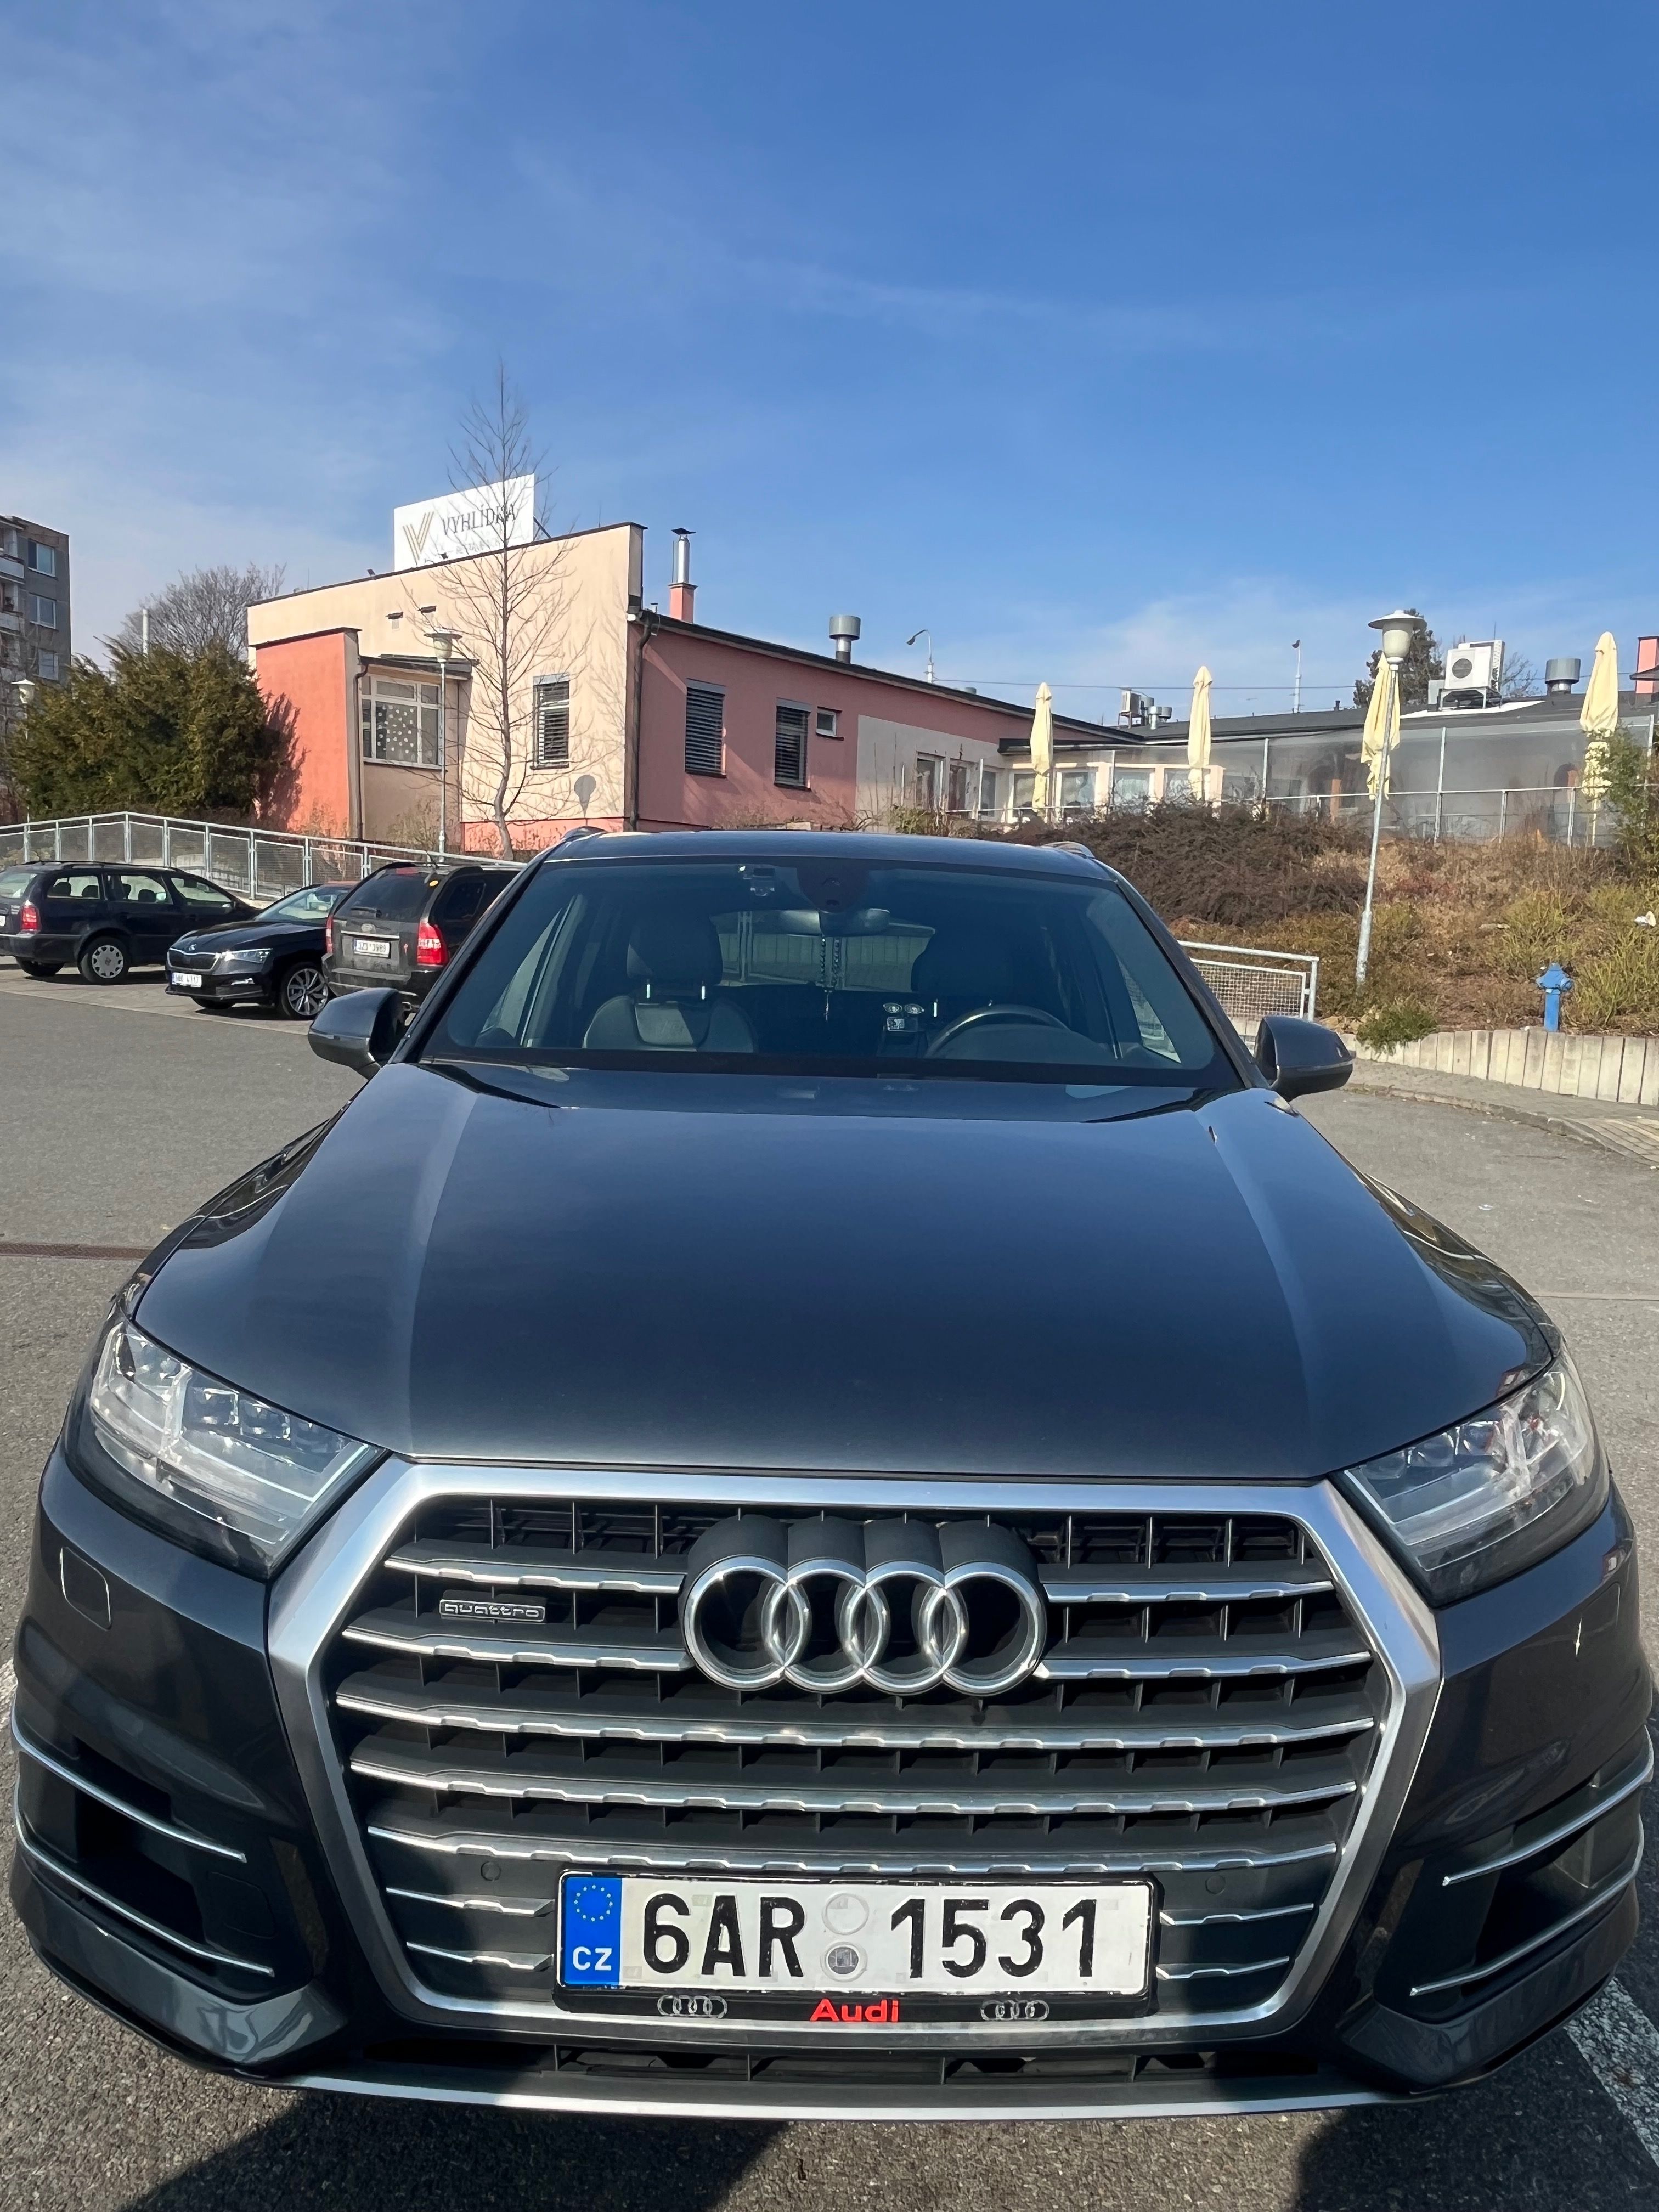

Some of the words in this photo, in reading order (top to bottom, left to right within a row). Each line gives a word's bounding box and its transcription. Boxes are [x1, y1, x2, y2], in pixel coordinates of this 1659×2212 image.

[442, 503, 516, 535] VYHLÍDKA
[444, 1603, 539, 1617] quattro
[642, 1893, 805, 1977] 6AR
[890, 1898, 1097, 1978] 1531
[572, 1946, 612, 1972] CZ
[810, 1999, 899, 2022] Audi
